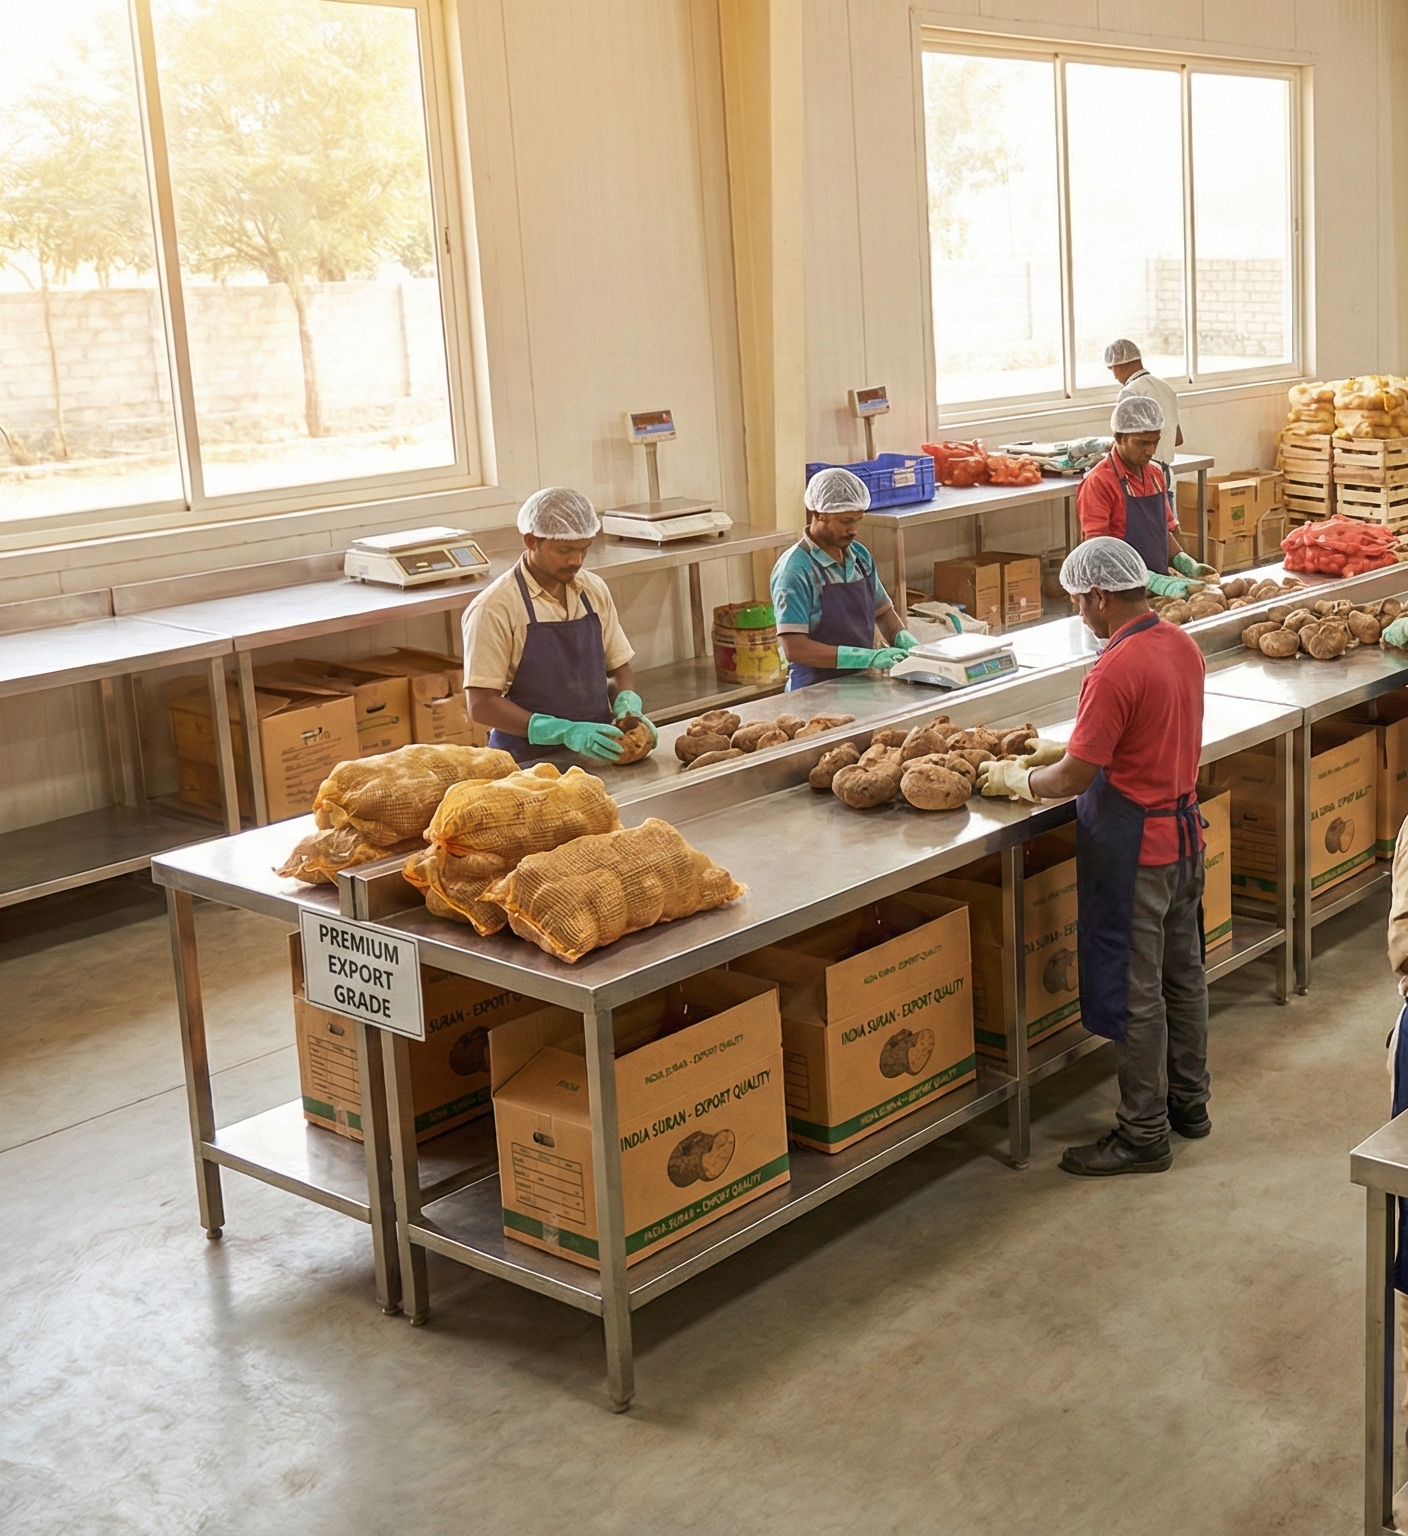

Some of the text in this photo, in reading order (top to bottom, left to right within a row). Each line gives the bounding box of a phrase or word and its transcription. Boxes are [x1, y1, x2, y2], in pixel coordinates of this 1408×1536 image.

[319, 924, 399, 965] PREMIUM
[328, 955, 394, 990] EXPORT
[333, 985, 392, 1018] GRADE
[619, 1127, 650, 1152] INDIA
[652, 1110, 686, 1137] SURAN
[694, 1088, 730, 1118] EXPORT
[733, 1068, 771, 1099] QUALITY
